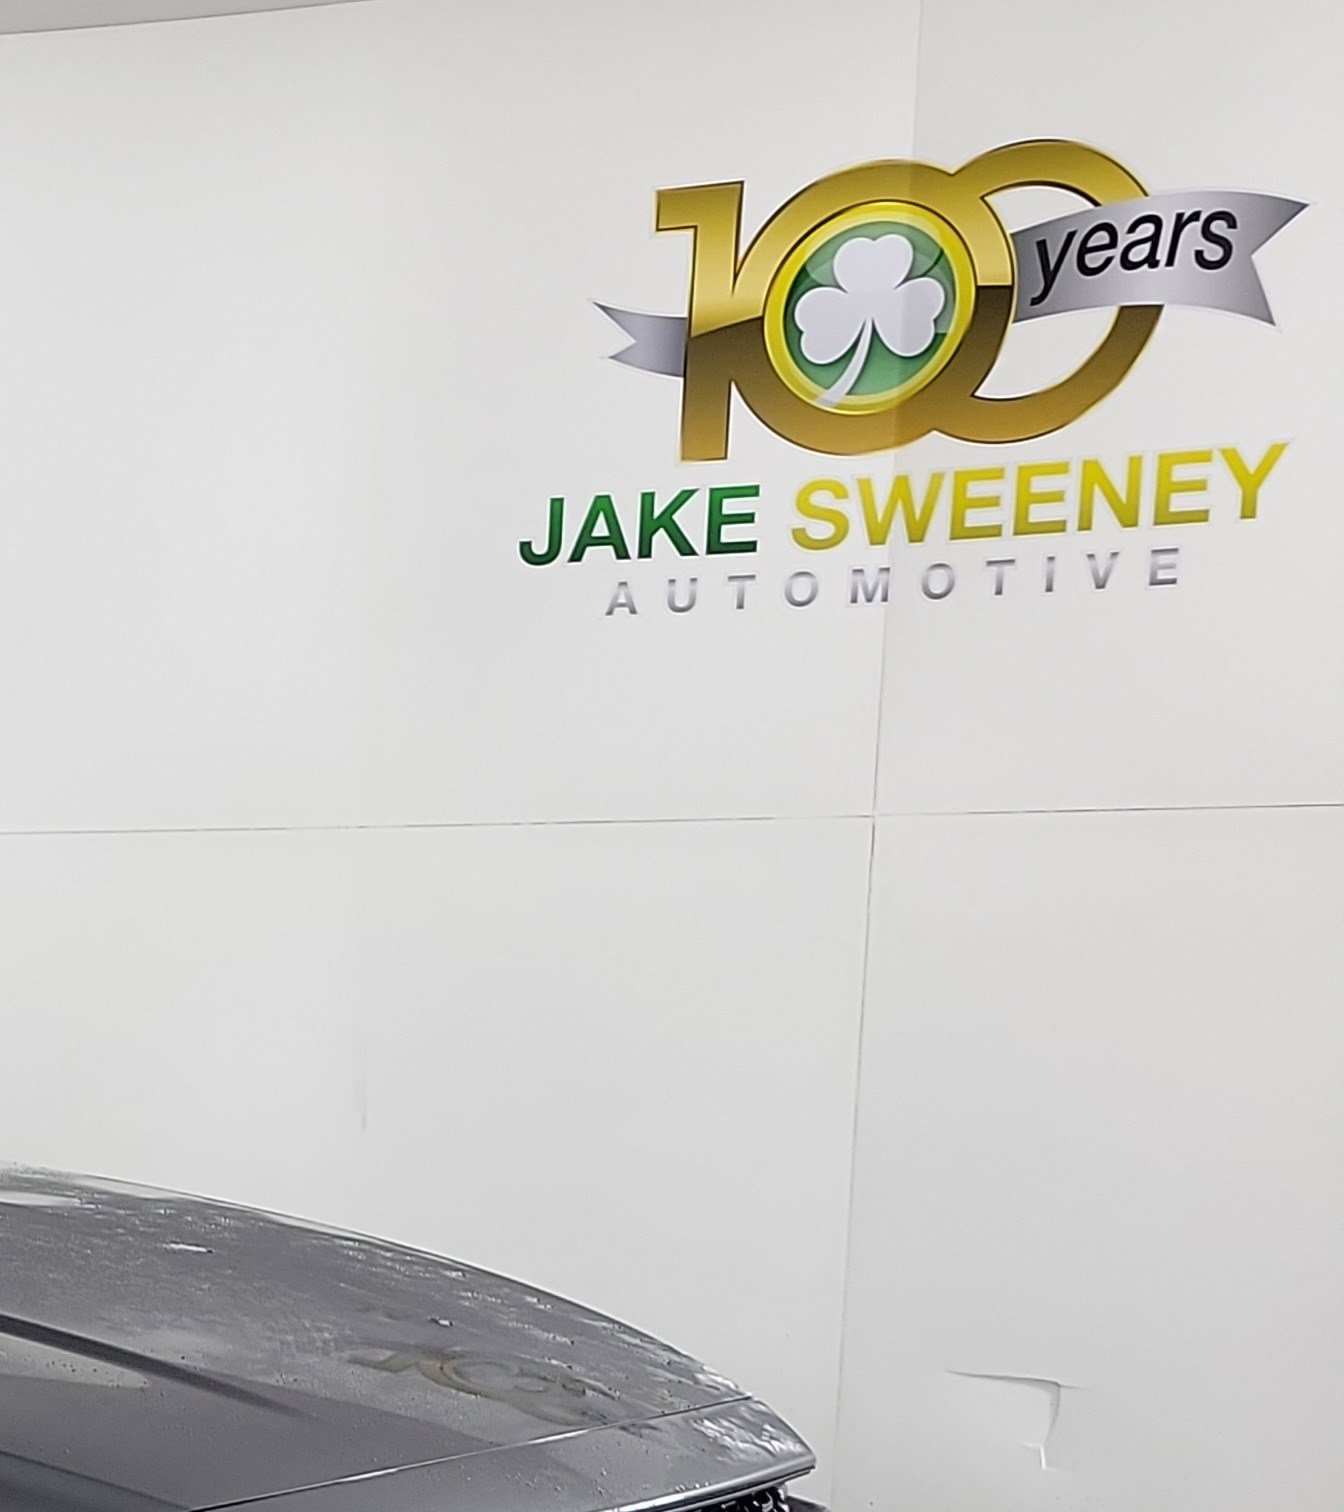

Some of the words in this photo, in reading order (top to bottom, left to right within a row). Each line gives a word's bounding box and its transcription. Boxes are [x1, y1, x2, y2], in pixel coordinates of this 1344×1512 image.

[656, 138, 1164, 461] 100
[1030, 209, 1238, 306] years
[519, 484, 762, 566] JAKE
[791, 442, 1291, 551] SWEENEY
[605, 548, 1180, 617] AUTOMOTIVE
